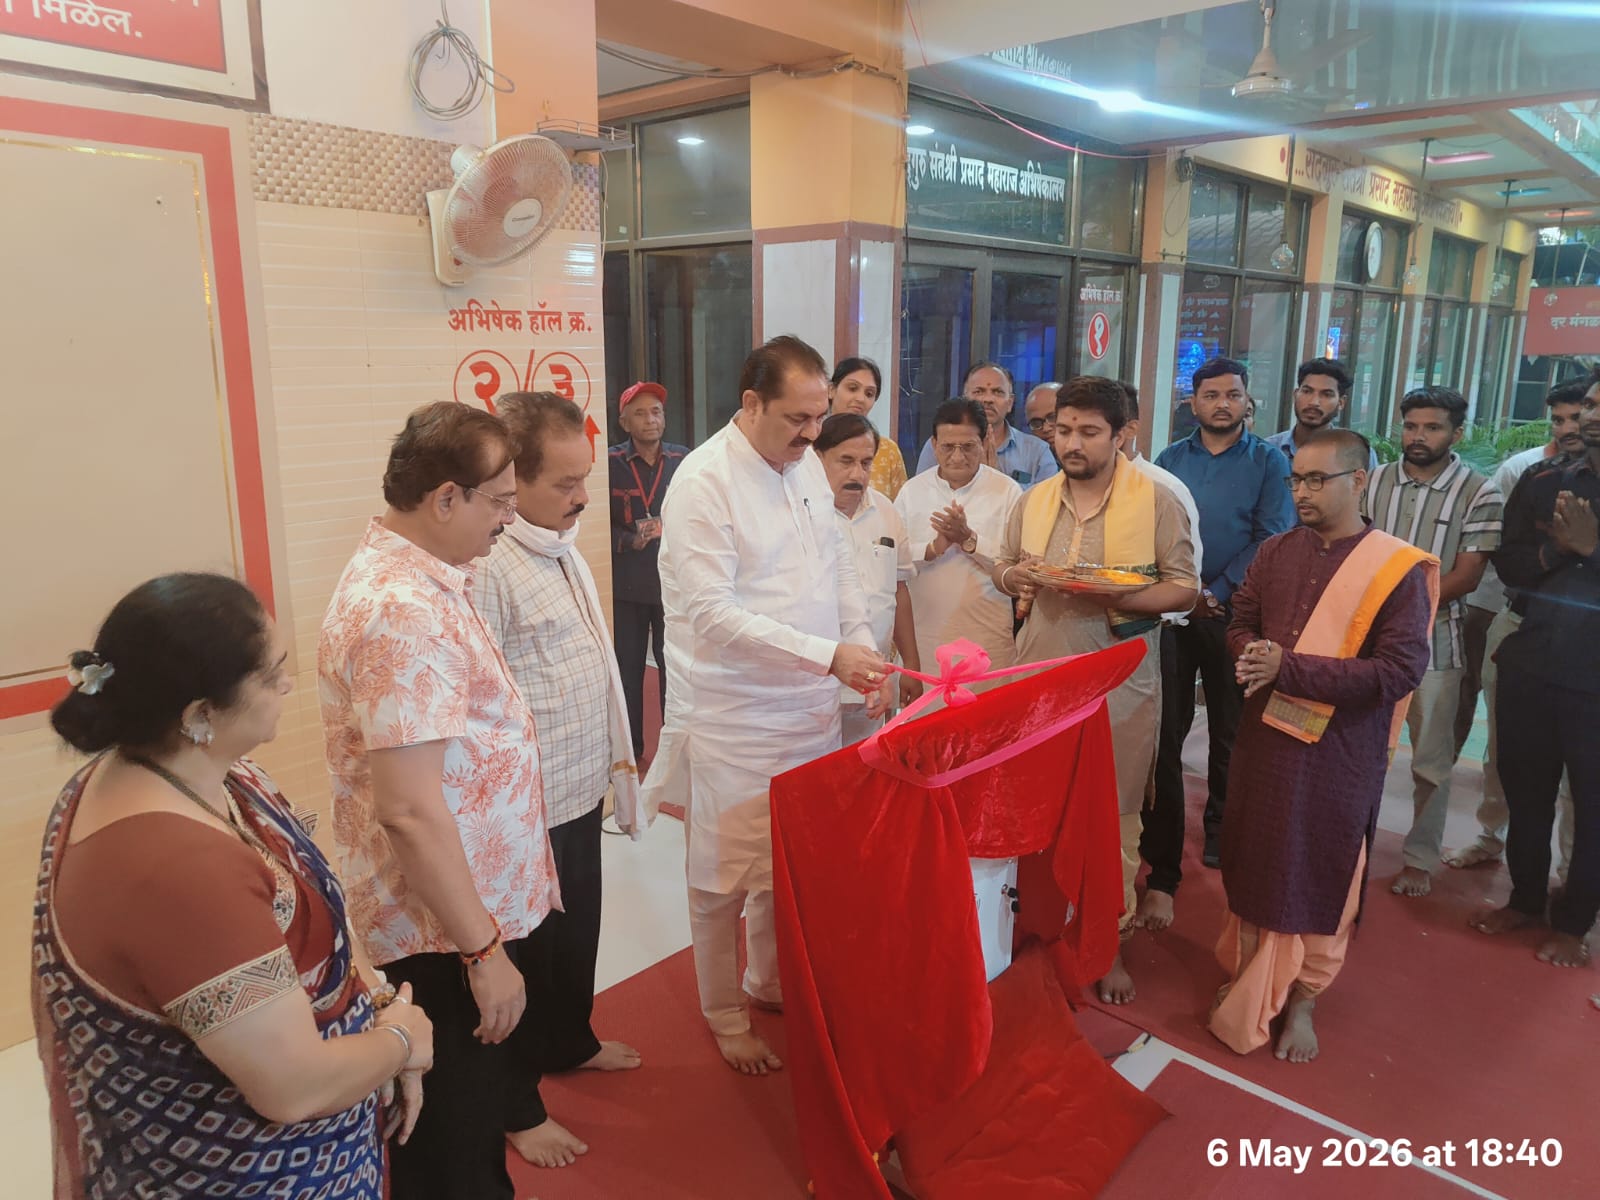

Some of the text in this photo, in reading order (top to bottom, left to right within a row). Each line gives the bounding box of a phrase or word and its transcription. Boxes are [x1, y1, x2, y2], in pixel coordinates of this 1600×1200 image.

[960, 156, 985, 192] प्रसाद
[987, 162, 1018, 193] महाराज
[1019, 160, 1065, 202] अभिषेकालय
[448, 298, 592, 335] अभिषेक हॉल क्र.
